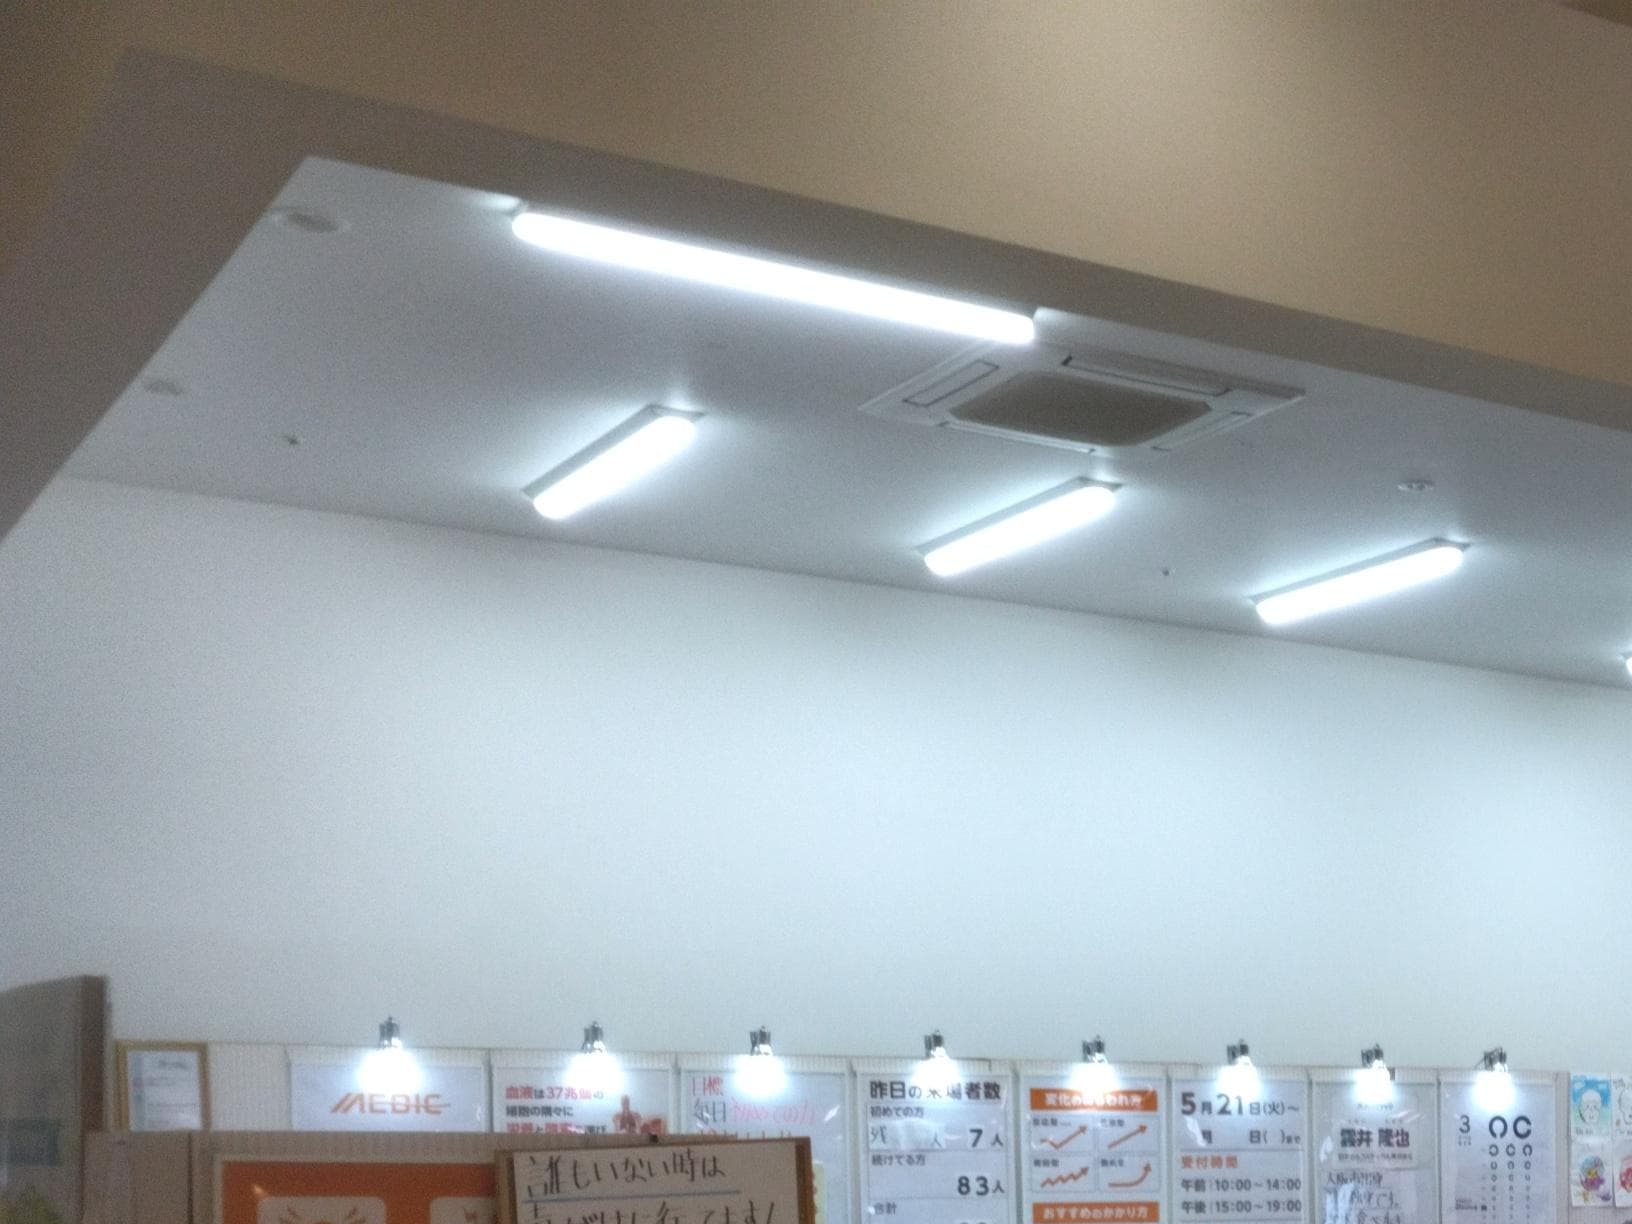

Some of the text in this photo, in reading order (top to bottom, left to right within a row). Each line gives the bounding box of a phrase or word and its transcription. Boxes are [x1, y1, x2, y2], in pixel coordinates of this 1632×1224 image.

[870, 1106, 925, 1119] 初めての方
[1181, 1155, 1239, 1170] 受付時間
[526, 1148, 726, 1198] 誰もいない時は
[1181, 1178, 1206, 1193] 午前
[1181, 1200, 1207, 1215] 午後
